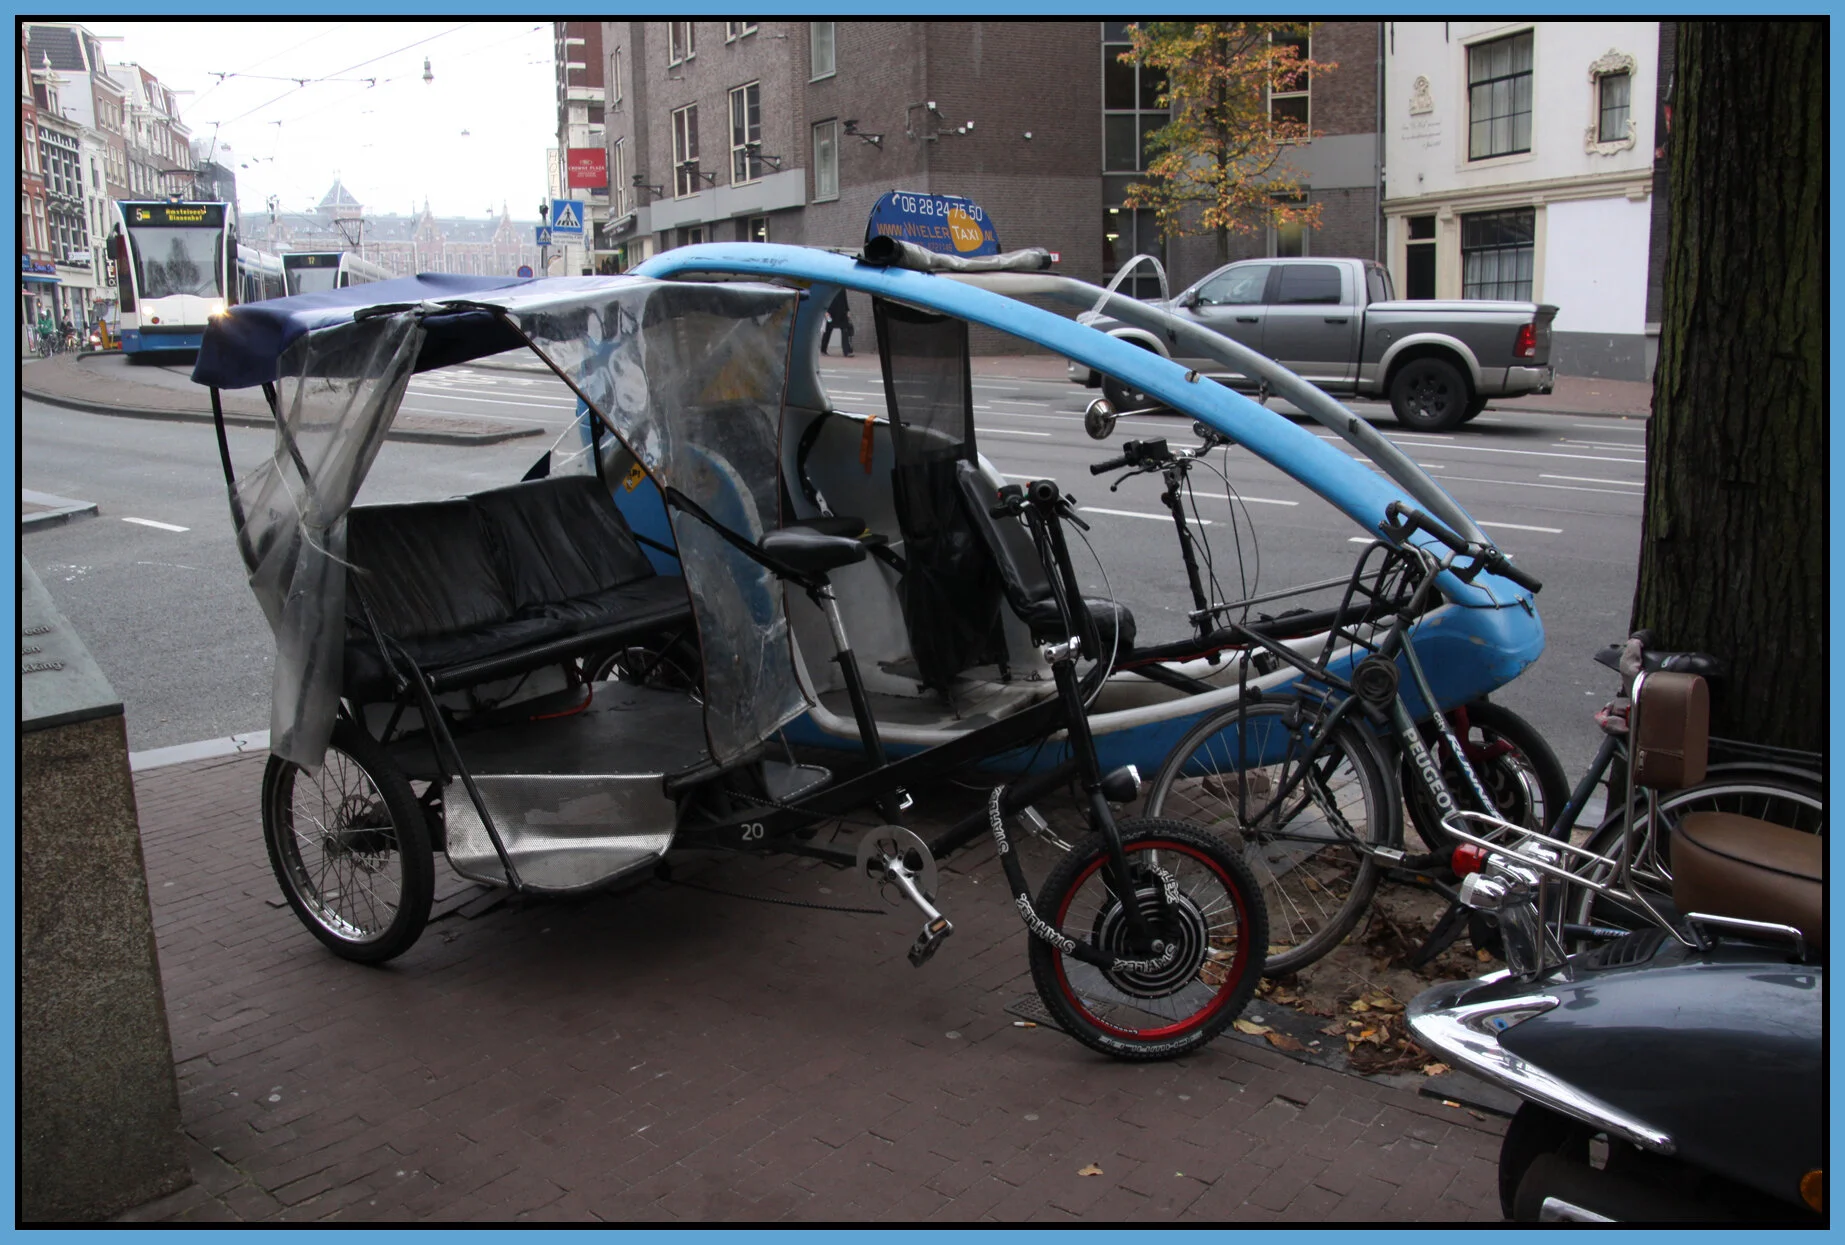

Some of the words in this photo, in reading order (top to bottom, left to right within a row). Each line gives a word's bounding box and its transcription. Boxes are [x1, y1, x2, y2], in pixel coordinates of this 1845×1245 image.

[549, 151, 560, 196] HOTE
[136, 208, 143, 221] 5
[901, 196, 917, 213] 06
[919, 198, 934, 216] 28
[935, 201, 950, 217] 24
[952, 203, 967, 220] 75
[968, 205, 983, 222] 50
[1402, 727, 1458, 820] PEUGEOT
[741, 822, 764, 840] 20
